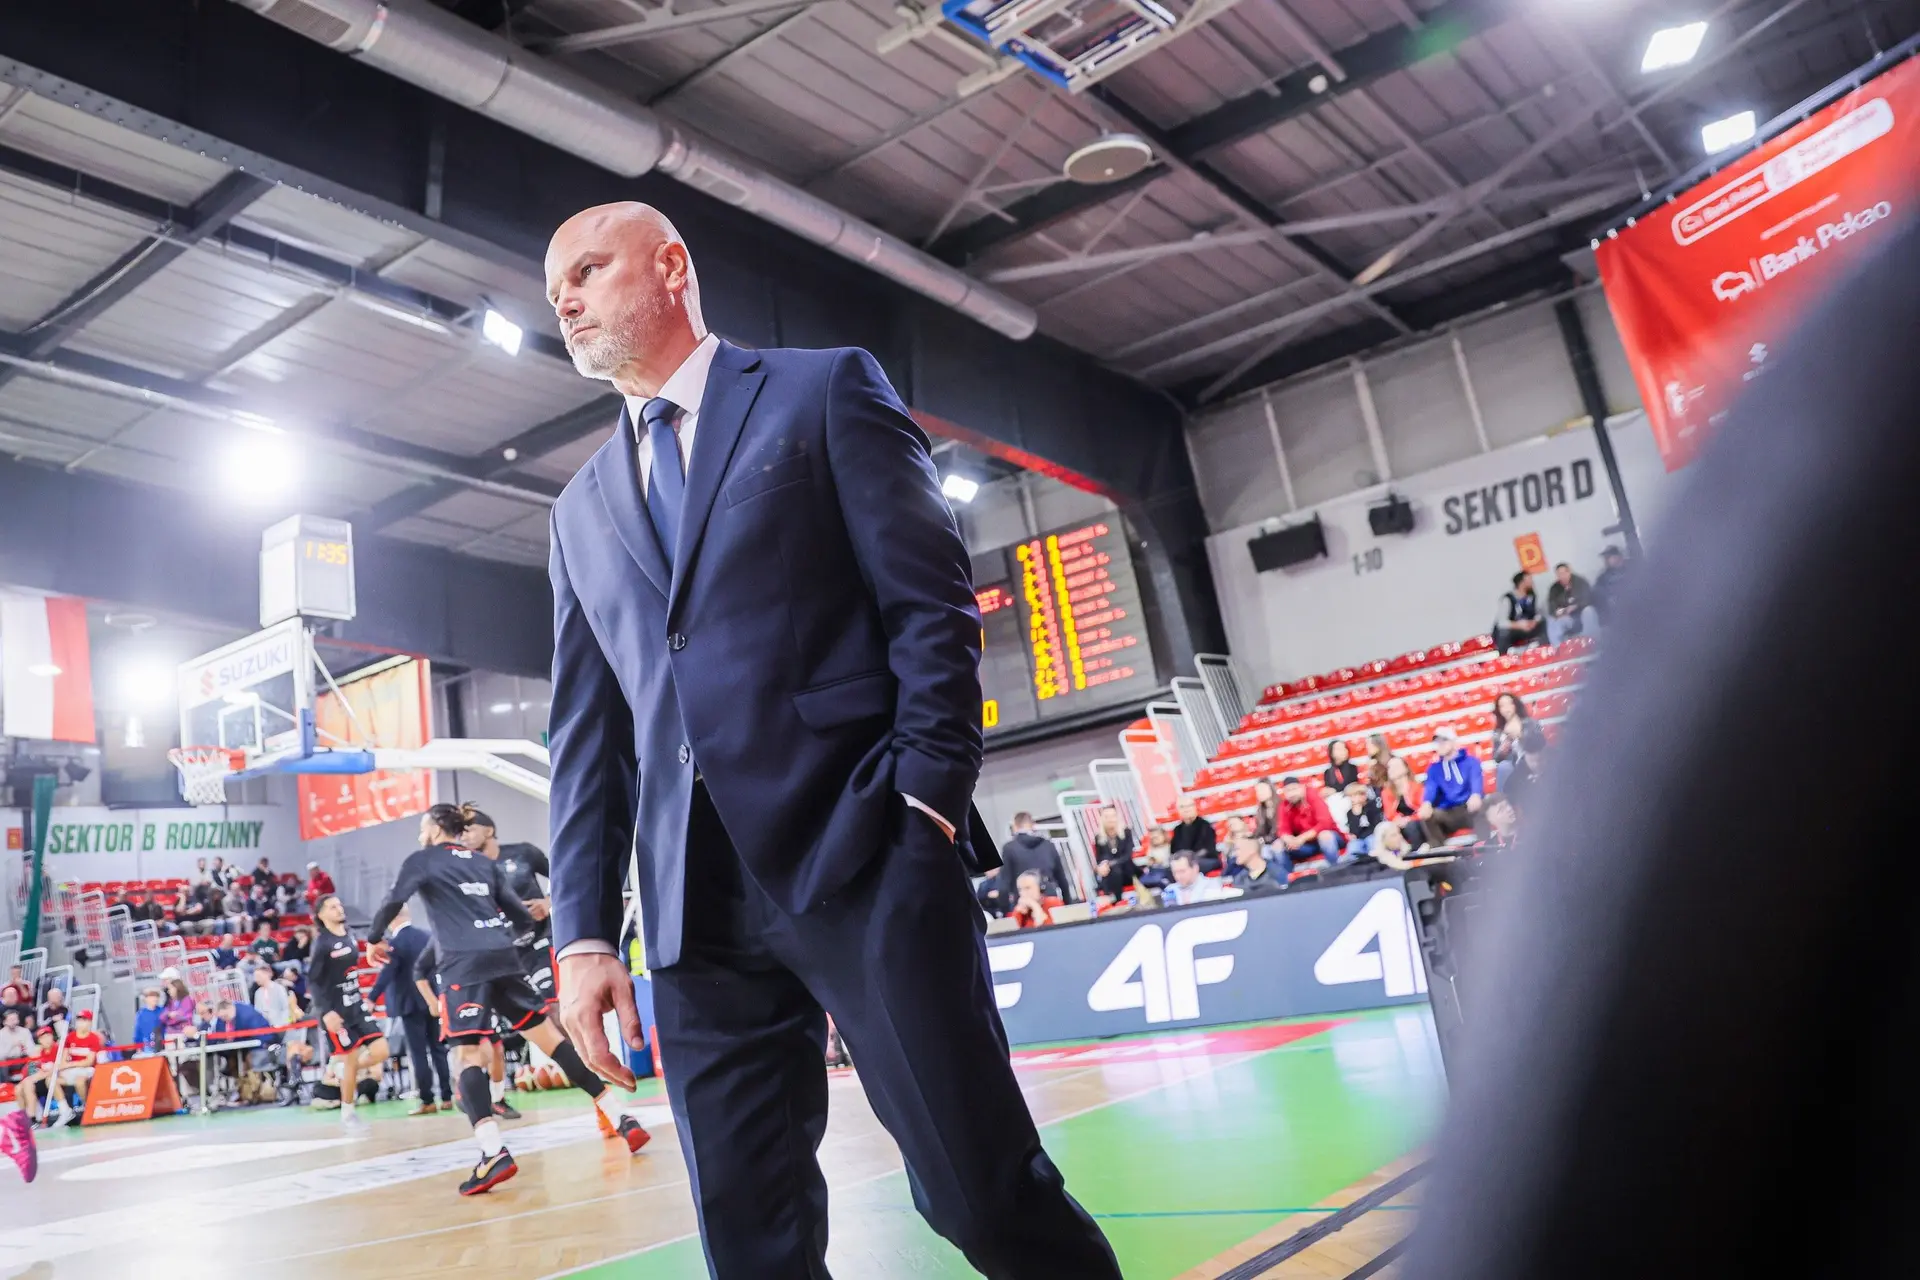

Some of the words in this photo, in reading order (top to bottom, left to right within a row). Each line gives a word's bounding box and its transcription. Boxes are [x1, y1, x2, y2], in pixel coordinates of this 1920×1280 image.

[1760, 235, 1820, 281] Bank
[1816, 201, 1892, 250] Pekao
[1443, 465, 1566, 536] SEKTOR
[1572, 459, 1594, 500] D
[1518, 542, 1541, 567] D
[219, 643, 288, 686] SUZUKI
[49, 822, 133, 854] SEKTOR
[142, 821, 156, 851] B
[165, 820, 264, 850] RODZINNY
[1087, 909, 1248, 1024] 4F
[1313, 888, 1429, 997] 4
